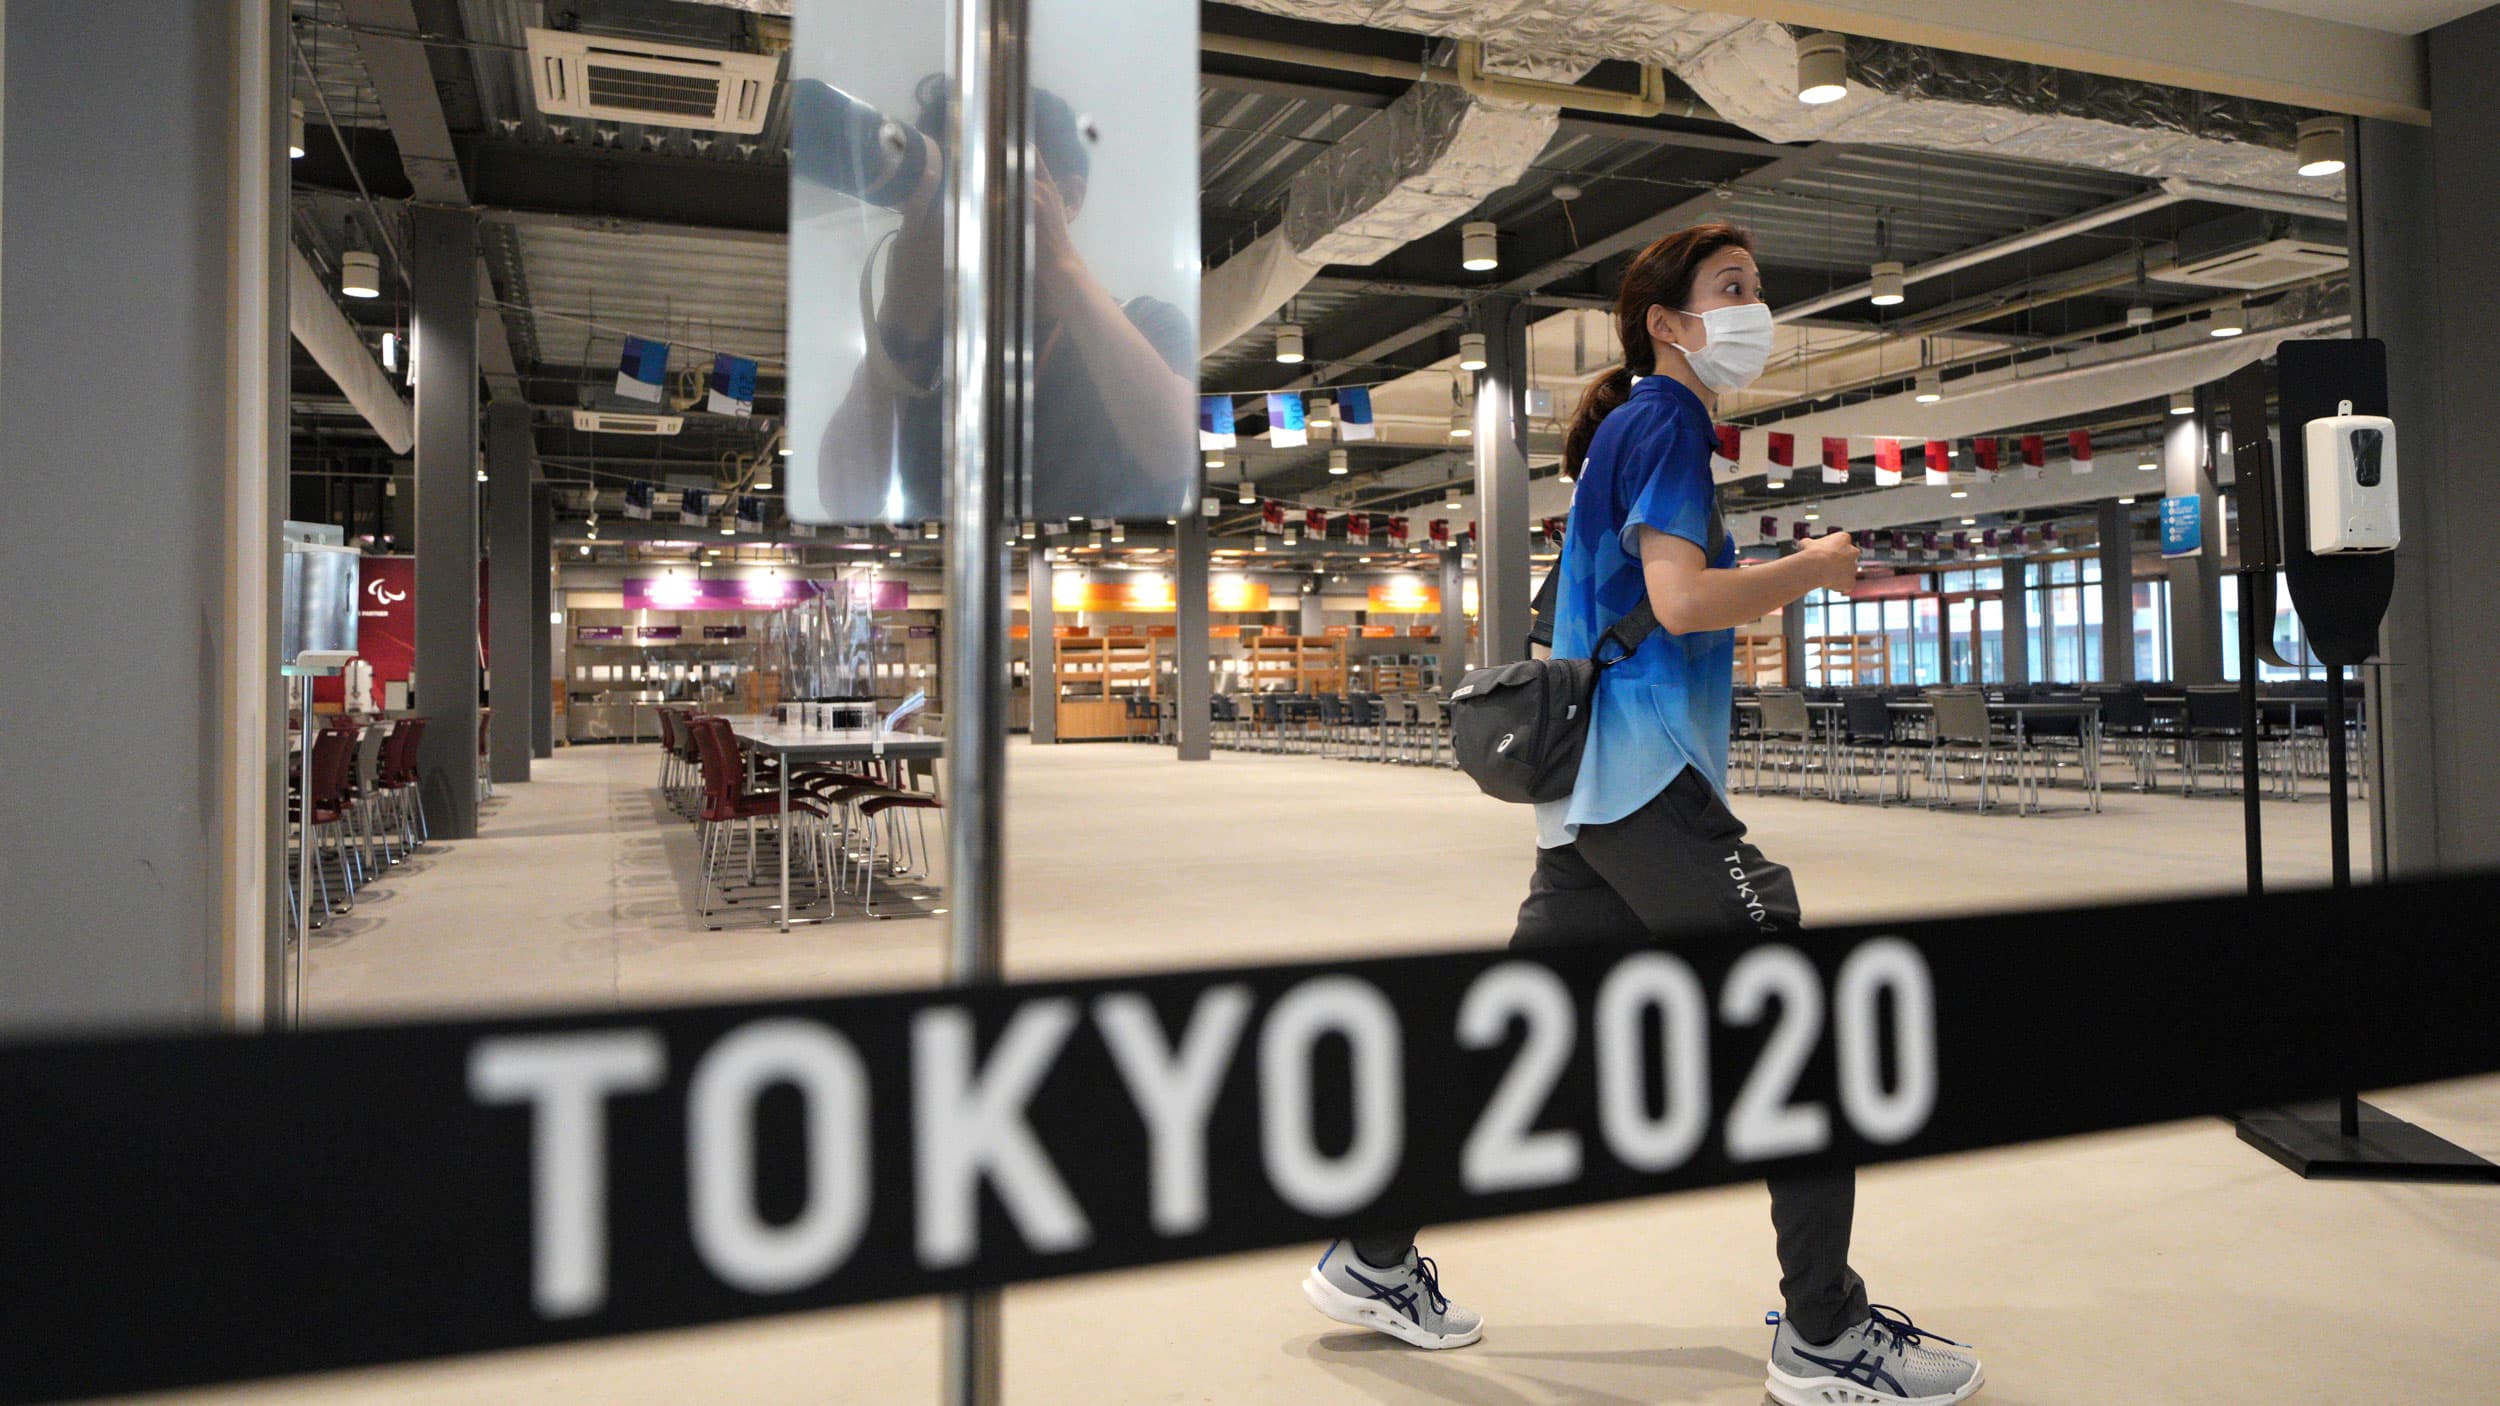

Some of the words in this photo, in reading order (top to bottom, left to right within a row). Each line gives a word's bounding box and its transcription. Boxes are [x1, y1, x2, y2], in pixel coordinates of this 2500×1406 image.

[1723, 850, 1767, 923] TOKYO
[468, 972, 1405, 1318] TOKYO
[1456, 938, 1937, 1192] 2020
